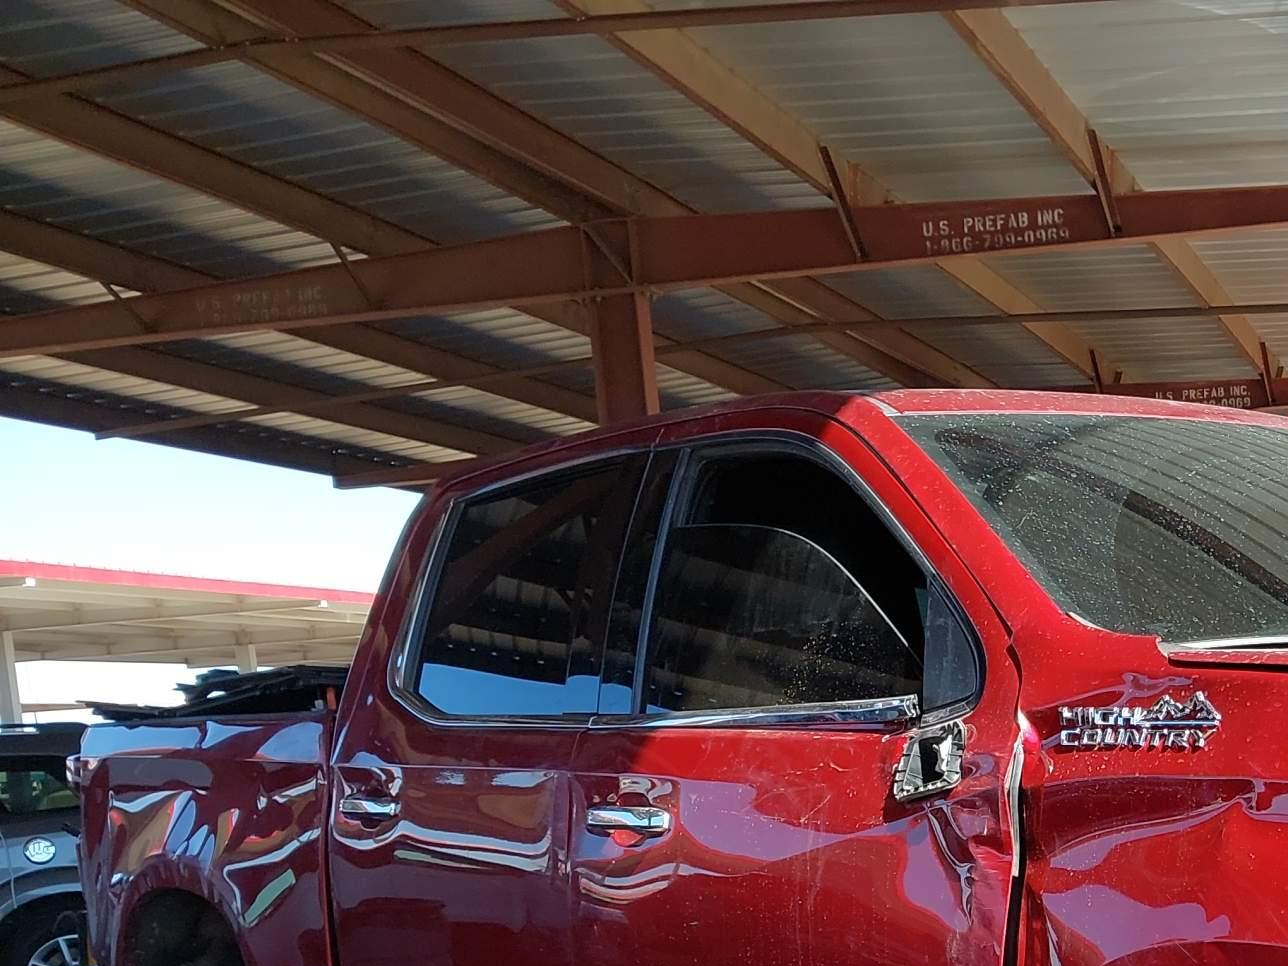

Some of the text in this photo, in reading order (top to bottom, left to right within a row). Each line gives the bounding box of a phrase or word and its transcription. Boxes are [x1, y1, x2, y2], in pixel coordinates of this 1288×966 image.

[922, 208, 1064, 237] U.S. PREFAB INC
[1182, 387, 1225, 401] PREFAB
[1230, 385, 1251, 397] INC.
[1058, 706, 1146, 726] HIGH
[1060, 727, 1217, 748] COUNTRY
